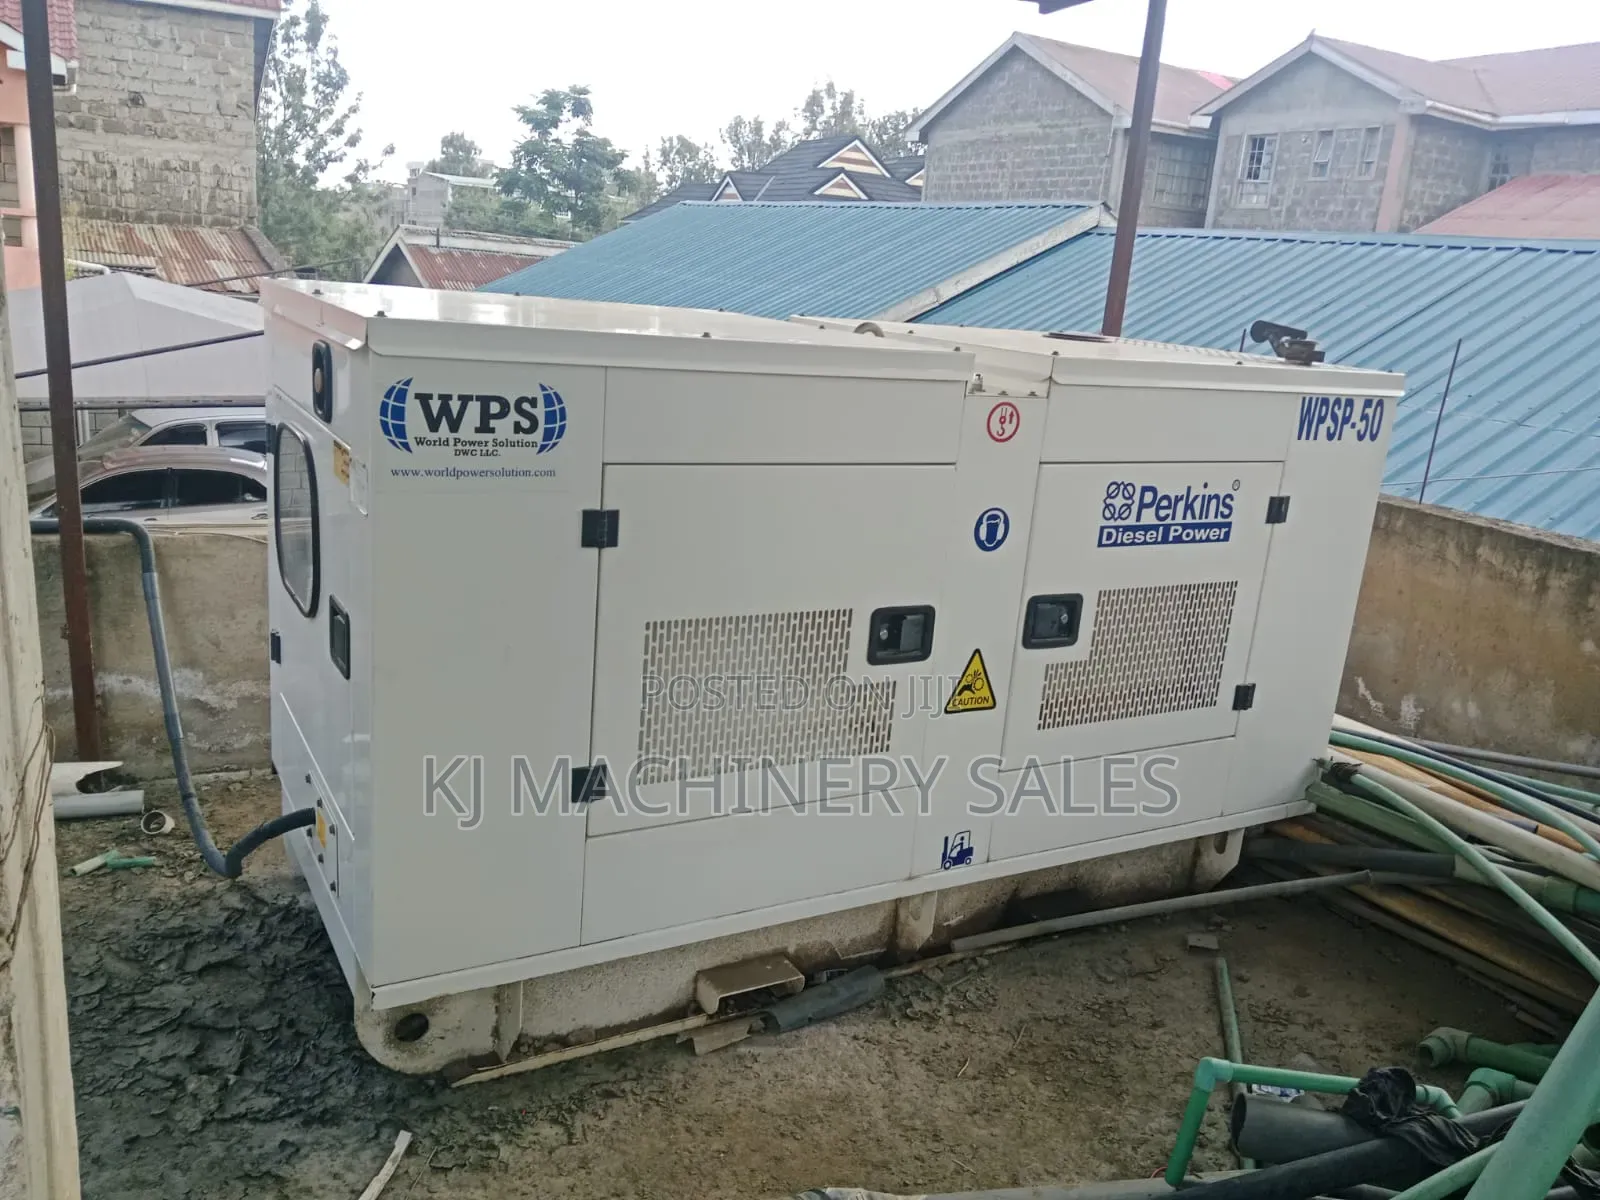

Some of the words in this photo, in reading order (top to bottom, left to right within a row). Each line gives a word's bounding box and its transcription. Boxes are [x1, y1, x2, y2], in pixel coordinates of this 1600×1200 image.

[414, 392, 539, 435] WPS
[1297, 396, 1384, 442] WPSP-50
[414, 437, 449, 447] World
[453, 437, 489, 448] Power
[492, 438, 538, 448] Solution
[454, 449, 478, 457] DWC
[391, 467, 556, 480] www.worldpowersolution.com
[1136, 482, 1234, 523] Perkins
[1102, 526, 1162, 545] Diesel
[1168, 524, 1228, 542] Power
[952, 695, 989, 707] CAUTION
